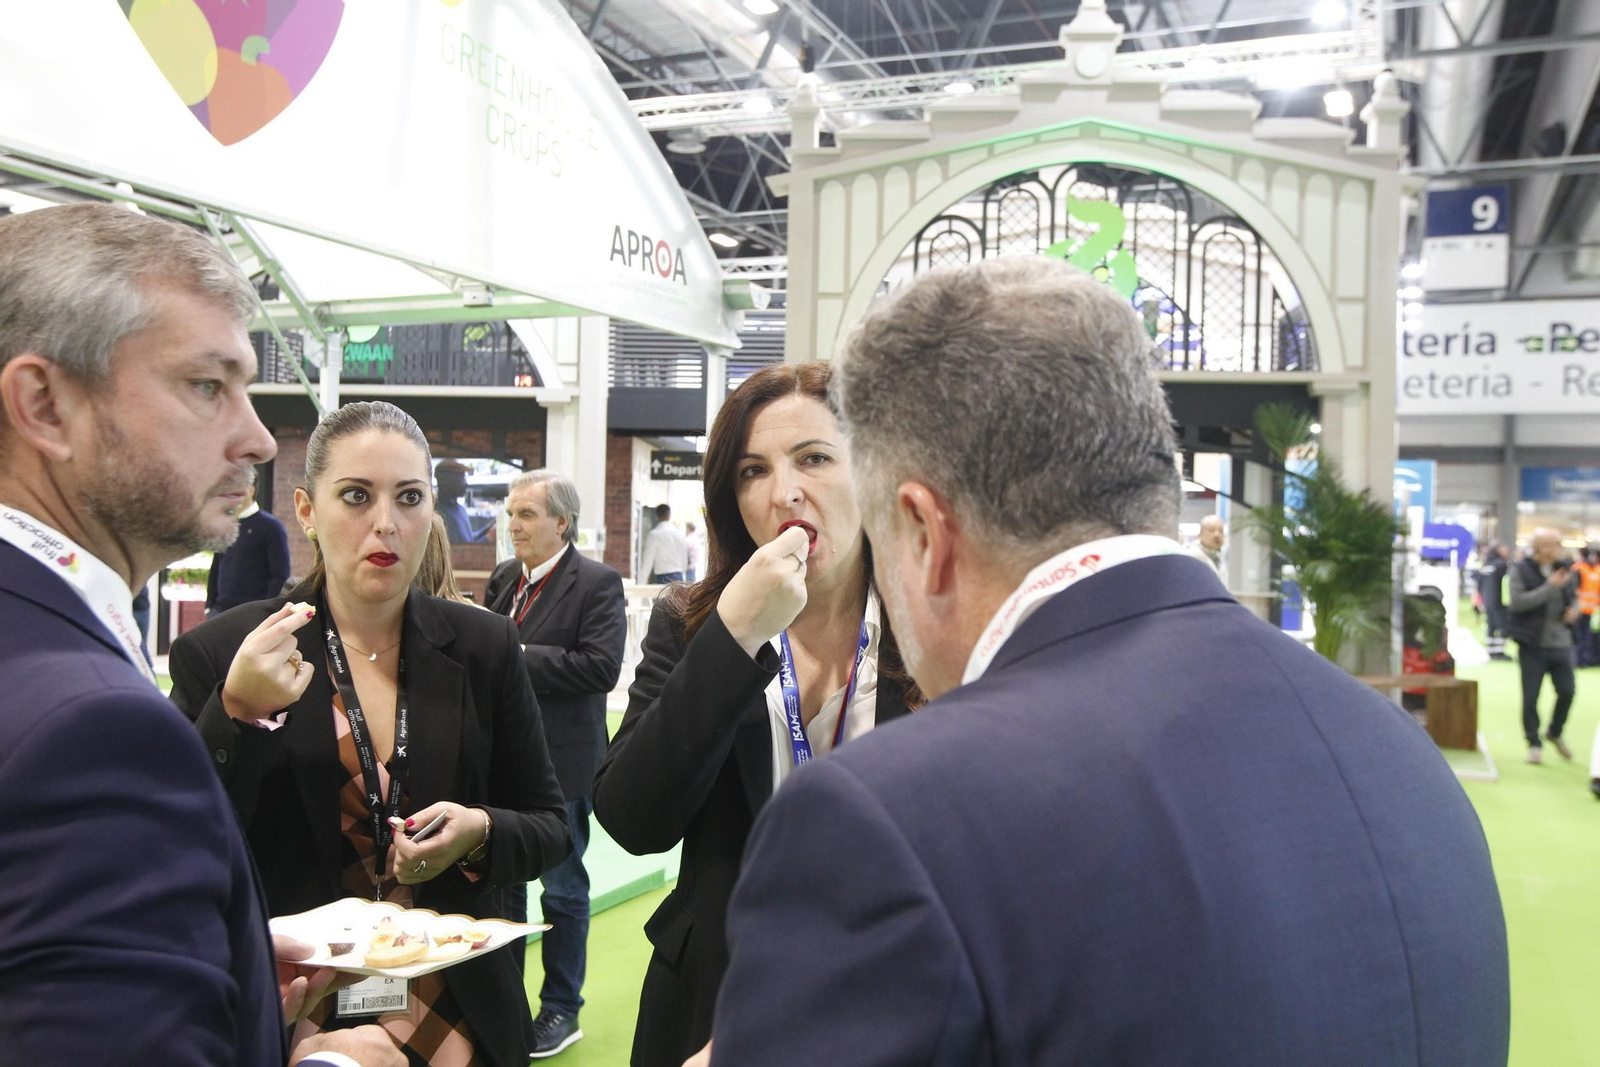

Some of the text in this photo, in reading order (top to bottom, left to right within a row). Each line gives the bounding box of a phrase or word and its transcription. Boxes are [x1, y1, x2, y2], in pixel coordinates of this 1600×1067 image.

[442, 23, 600, 151] GREENHOE
[486, 104, 562, 177] CROPS
[1471, 196, 1499, 231] 9
[610, 224, 688, 286] APROA
[1402, 322, 1496, 357] tería
[1403, 366, 1512, 398] eteria
[3, 512, 65, 550] attraction
[31, 540, 56, 560] fruit
[330, 645, 344, 674] AgroBank
[781, 661, 794, 687] ISAM
[347, 709, 361, 743] attraction
[353, 708, 364, 722] fruit
[791, 714, 804, 741] ISAM
